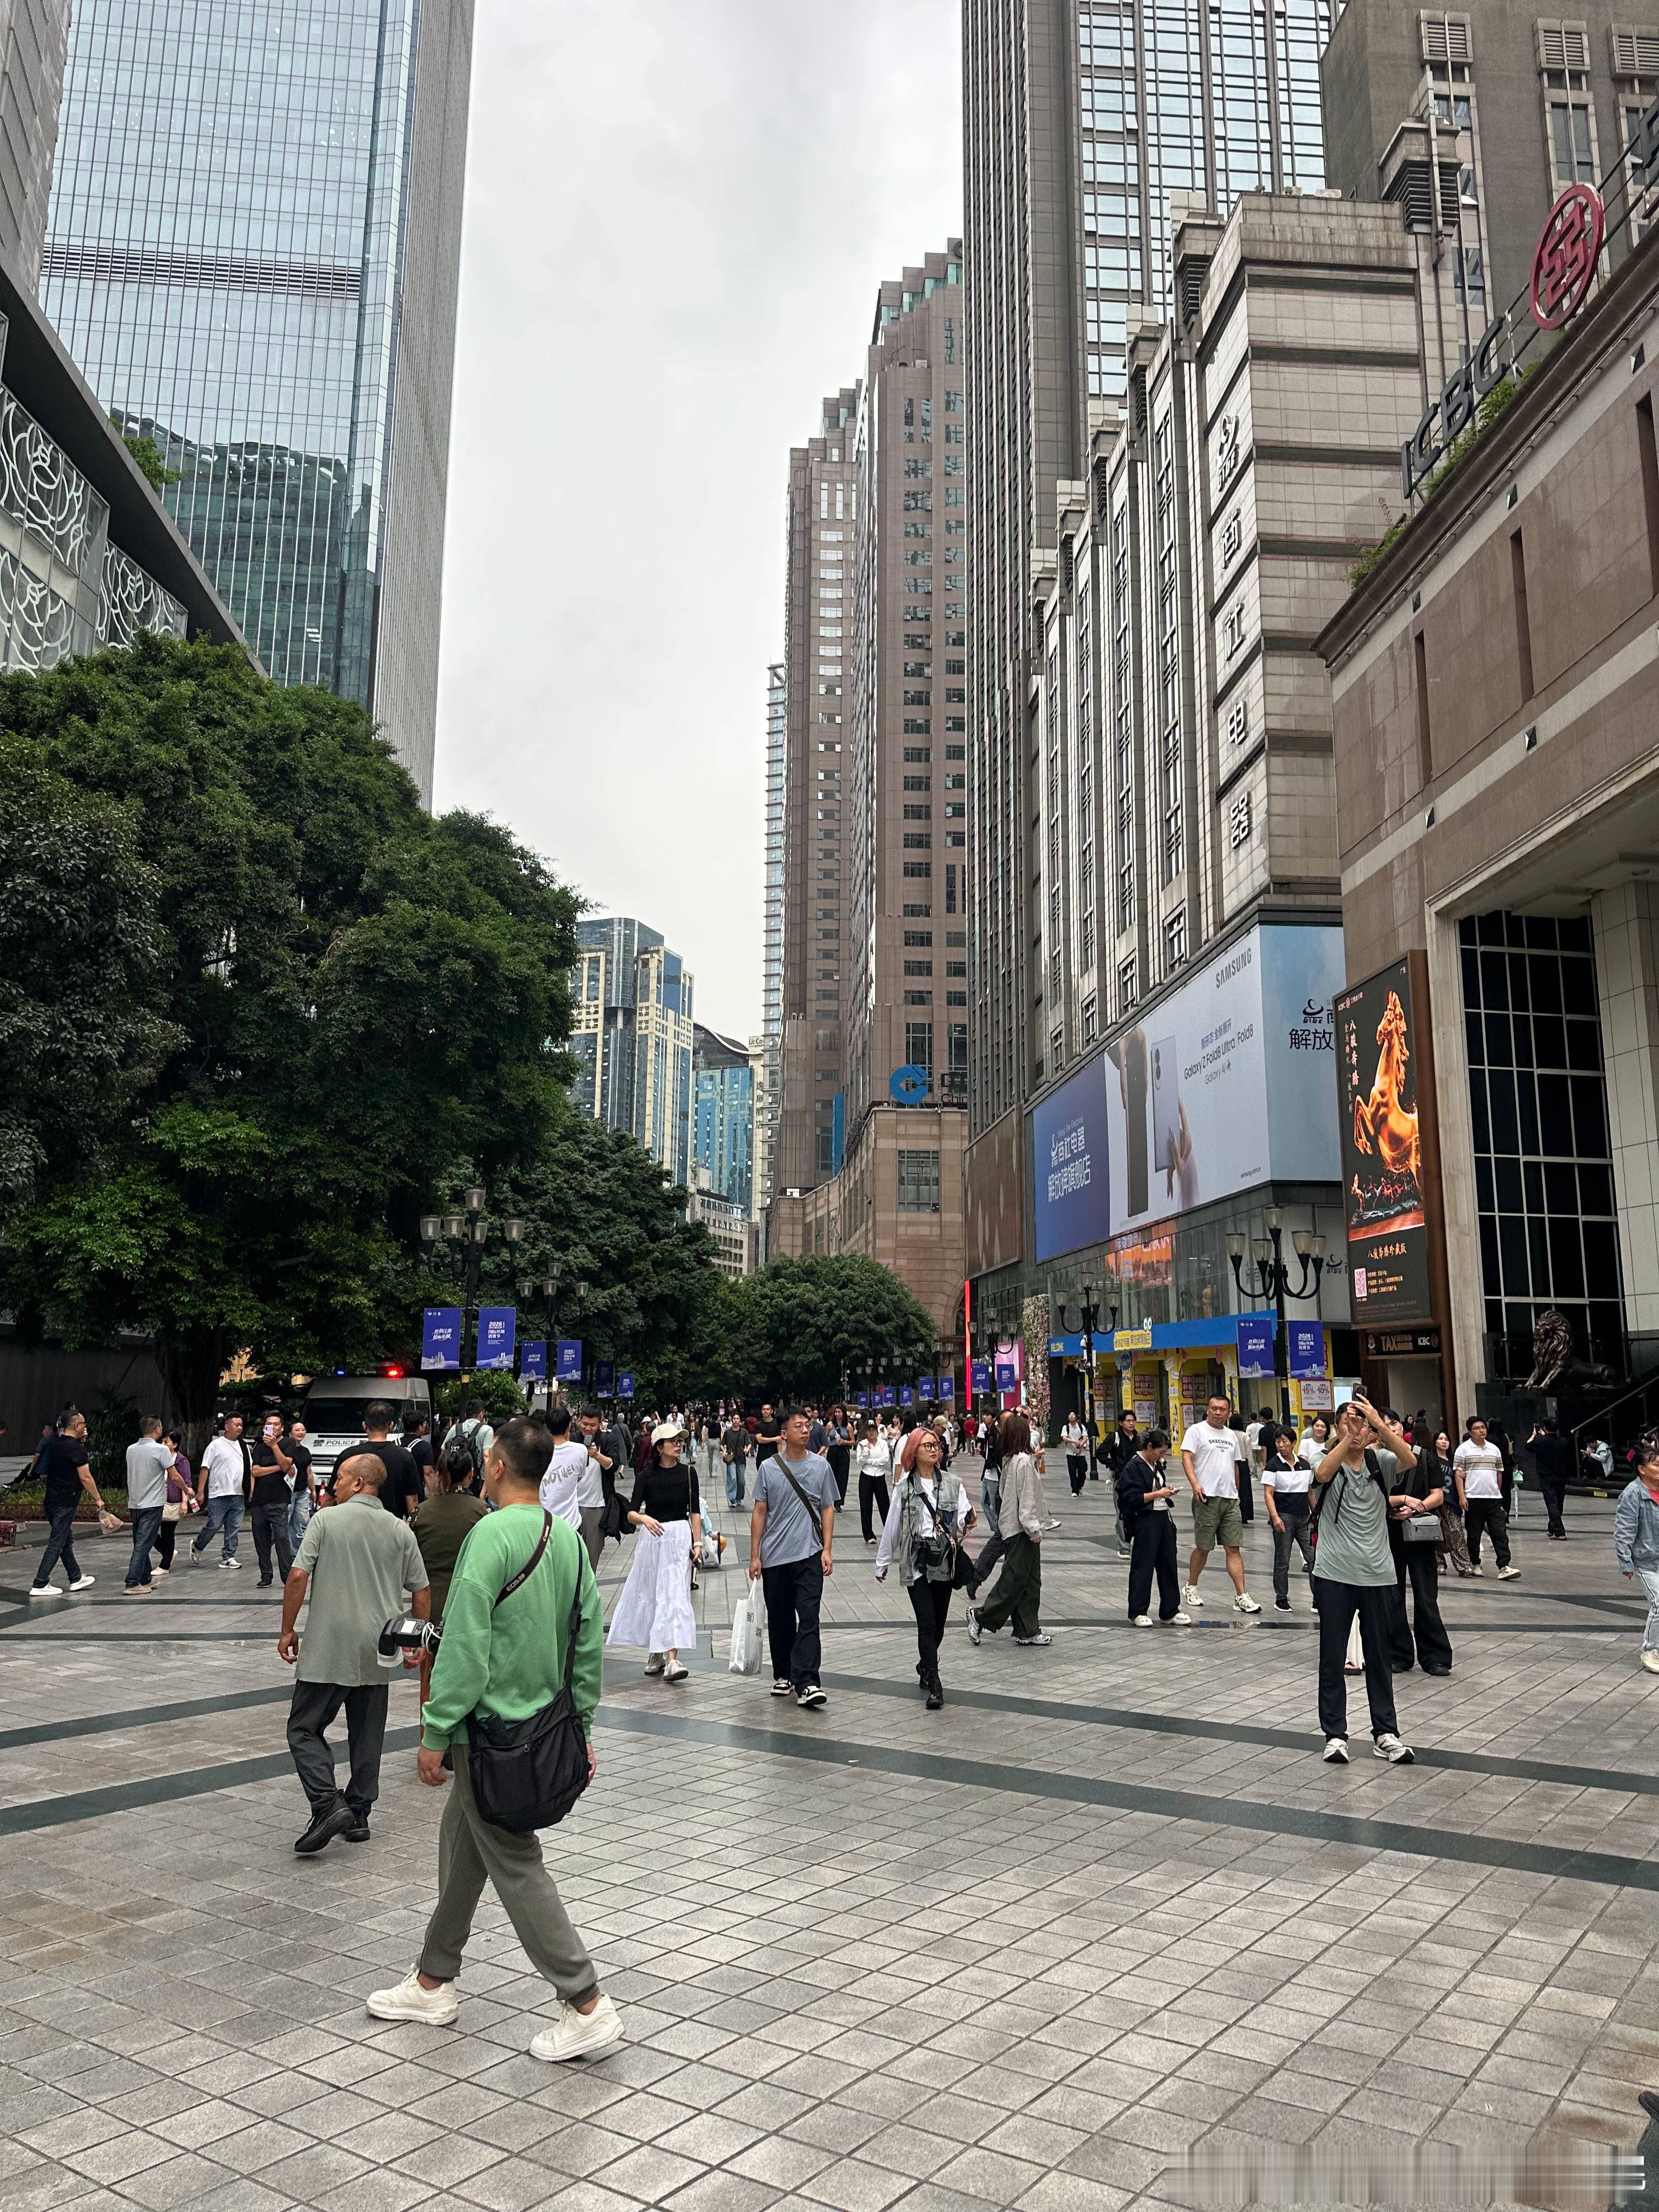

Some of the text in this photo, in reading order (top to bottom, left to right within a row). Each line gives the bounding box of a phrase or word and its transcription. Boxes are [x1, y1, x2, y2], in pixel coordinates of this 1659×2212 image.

[1401, 315, 1506, 499] ICBC
[1222, 508, 1251, 849] 商社电器
[1216, 947, 1251, 989] SAMSUNG
[1184, 1024, 1253, 1080] Galaxy Z Fold8 Ultra Fold8
[1289, 1028, 1334, 1051] 解放
[1205, 1068, 1221, 1085] Galaxy
[1058, 1126, 1085, 1163] 商社电器
[1048, 1153, 1091, 1203] 解放碑旗舰店
[1380, 1335, 1397, 1351] TAX
[1418, 1336, 1431, 1345] ICBC
